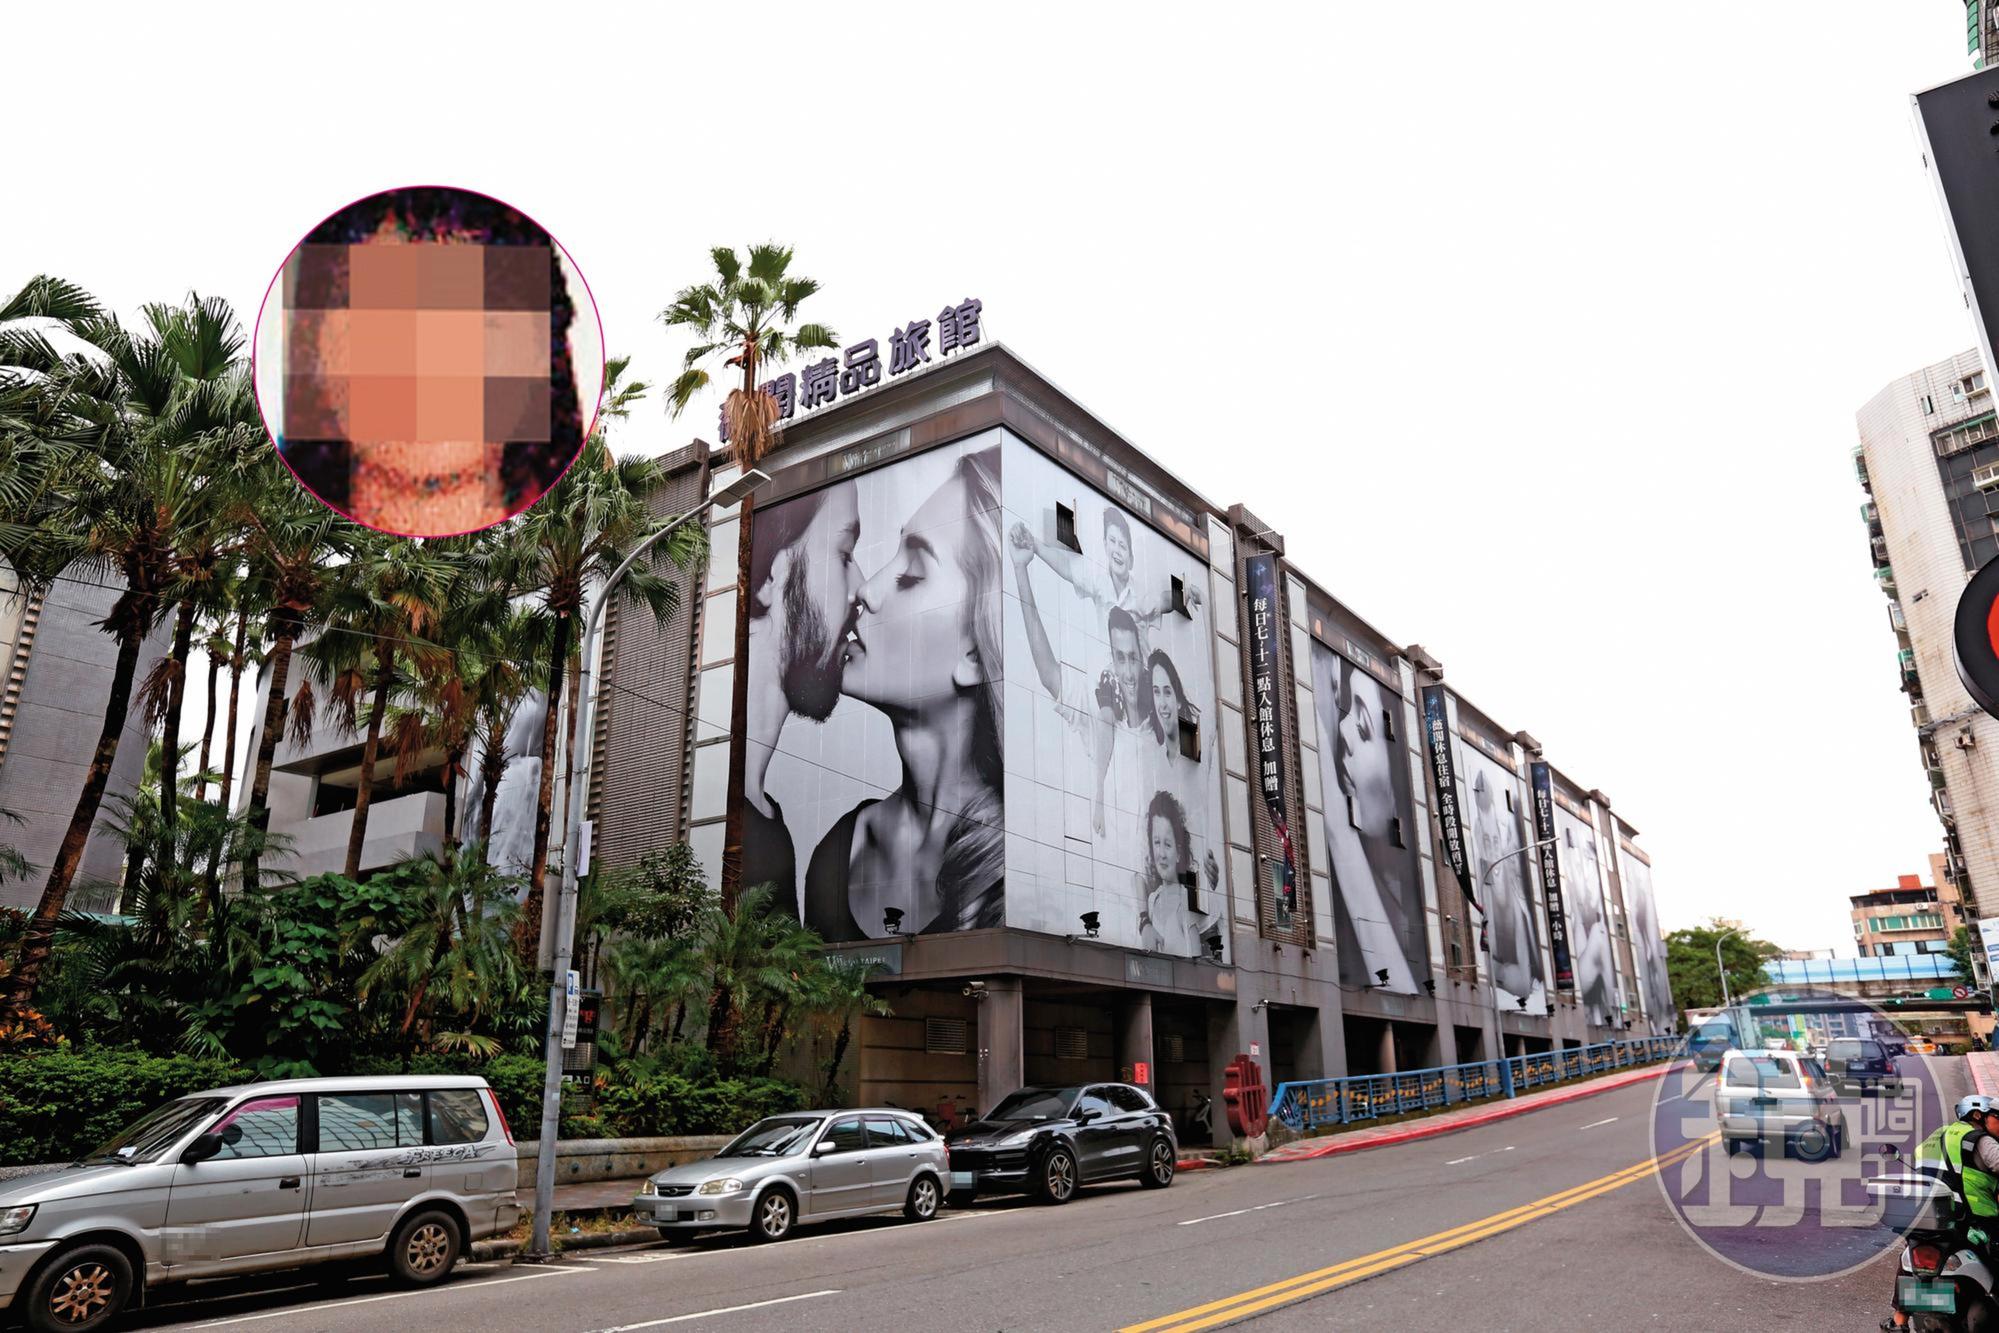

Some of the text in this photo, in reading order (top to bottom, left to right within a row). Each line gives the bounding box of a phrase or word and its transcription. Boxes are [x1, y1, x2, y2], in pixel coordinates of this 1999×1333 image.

[718, 297, 982, 443] 閣精品旅館
